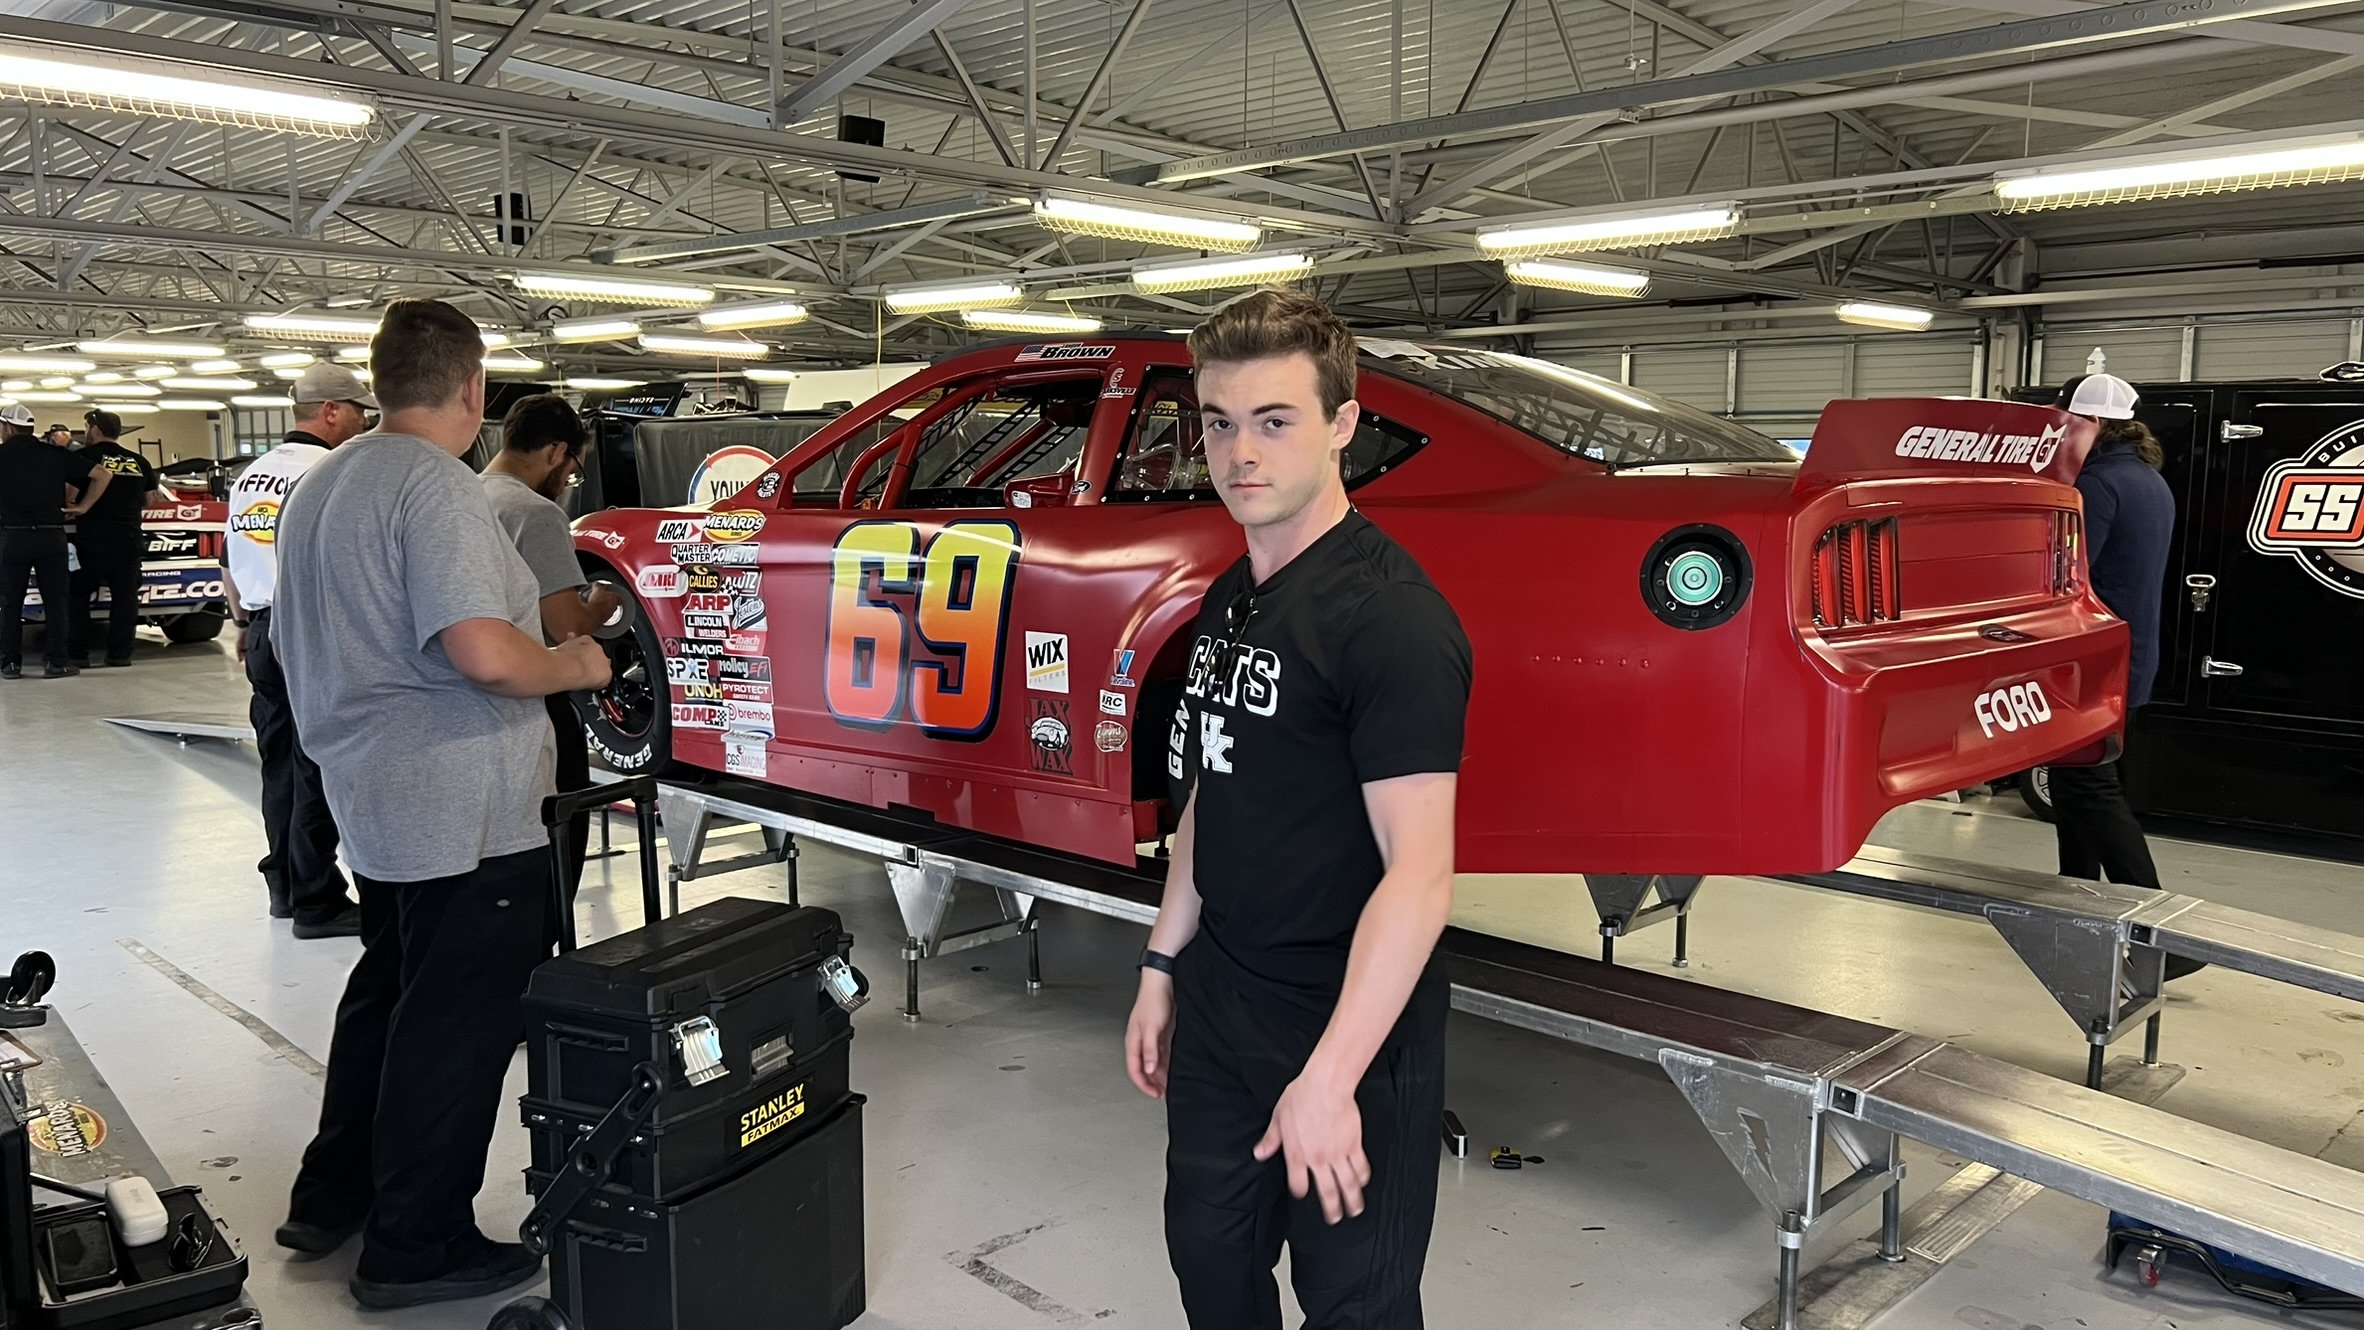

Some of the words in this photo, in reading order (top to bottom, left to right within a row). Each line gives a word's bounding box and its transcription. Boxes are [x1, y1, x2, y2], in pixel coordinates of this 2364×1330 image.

[1040, 346, 1113, 358] BROWN
[1895, 425, 2001, 463] GENERAL
[1993, 434, 2040, 464] TIRE
[2318, 432, 2364, 463] BUI
[239, 473, 295, 495] FFICI
[142, 509, 176, 519] TIRE
[2281, 484, 2364, 531] SS
[232, 514, 276, 532] MENA
[704, 514, 764, 531] MENARDS
[657, 522, 688, 540] ARCA
[148, 538, 197, 552] BIFF
[672, 544, 710, 557] QUARTER
[678, 553, 711, 563] MASTER
[711, 547, 756, 562] COMETIC
[689, 575, 719, 589] CALLIES
[685, 595, 731, 611] ARP
[687, 616, 723, 627] LINCOLN
[698, 629, 727, 638] WELDERS
[824, 519, 1022, 742] 69
[681, 643, 725, 656] ILMOR
[1028, 638, 1065, 669] WIX
[1029, 670, 1066, 686] FILTERS
[684, 683, 722, 699] UNOH
[723, 683, 769, 695] PYROTECT
[1101, 694, 1123, 708] IRC
[672, 706, 717, 722] COMP
[738, 708, 771, 721] brembo
[1974, 681, 2052, 739] FORD
[585, 723, 653, 769] GENERAL
[1030, 746, 1073, 775] WAX
[741, 1083, 804, 1132] STANLEY
[47, 1099, 89, 1157] MENARDS
[747, 1107, 797, 1142] FATMAX
